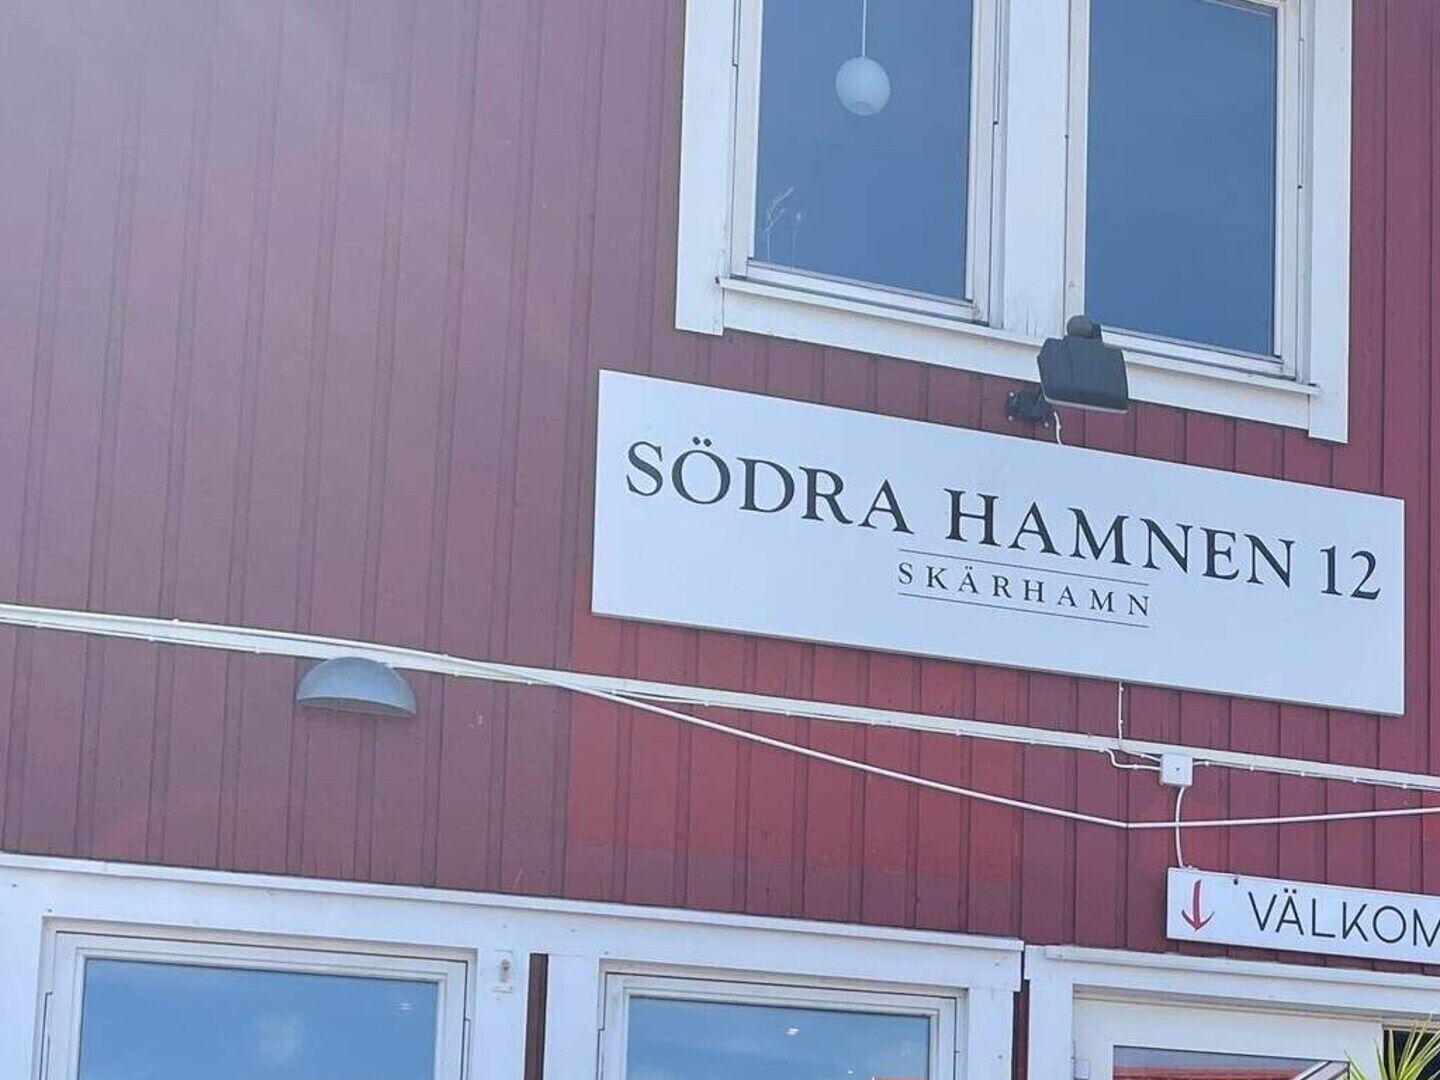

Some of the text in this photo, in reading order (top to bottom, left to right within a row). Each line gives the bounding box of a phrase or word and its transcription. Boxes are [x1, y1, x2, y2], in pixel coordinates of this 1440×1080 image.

[626, 437, 1382, 601] SÖDRA HAMNEN 12
[898, 560, 1150, 617] SKÄRHAMN
